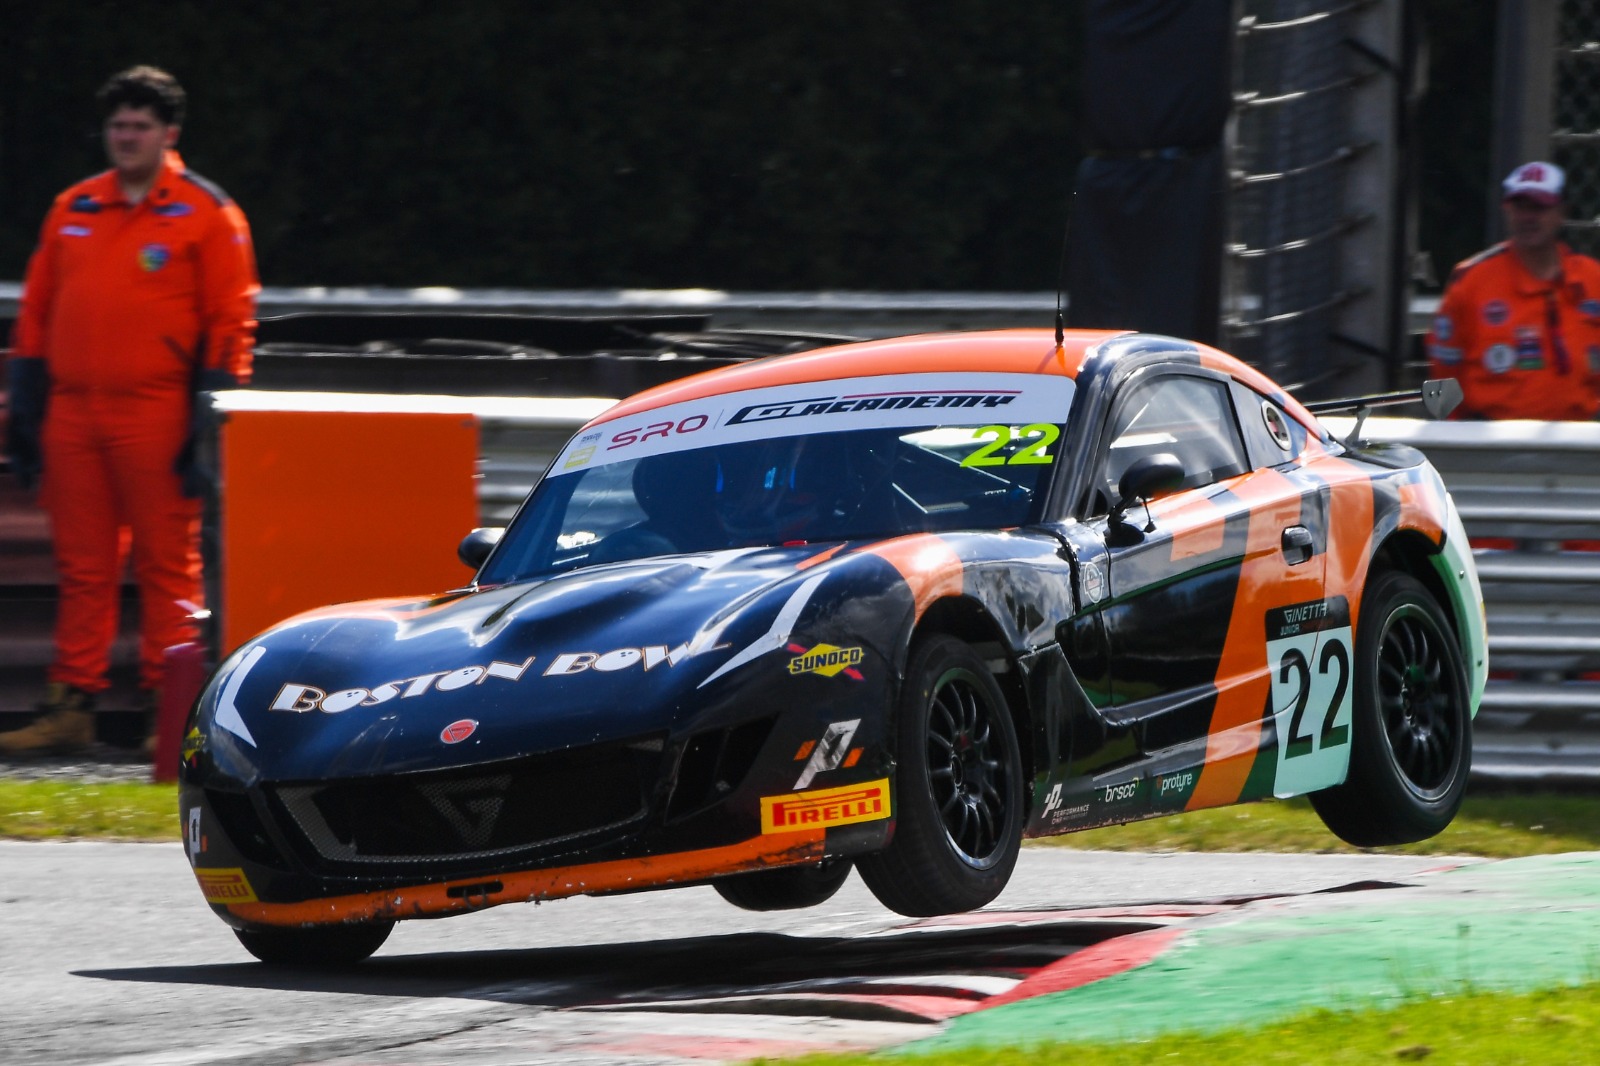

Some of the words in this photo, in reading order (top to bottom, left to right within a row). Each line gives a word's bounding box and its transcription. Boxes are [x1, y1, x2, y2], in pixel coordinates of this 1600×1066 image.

[607, 415, 708, 450] SRO
[960, 423, 1060, 468] 22
[1283, 602, 1328, 624] GINETTA
[793, 650, 860, 673] SUNOCO
[269, 656, 535, 714] BOSTON
[1280, 638, 1350, 759] 22
[1105, 784, 1137, 803] brscc
[1161, 773, 1193, 795] protyre
[773, 788, 881, 826] PIRELLI
